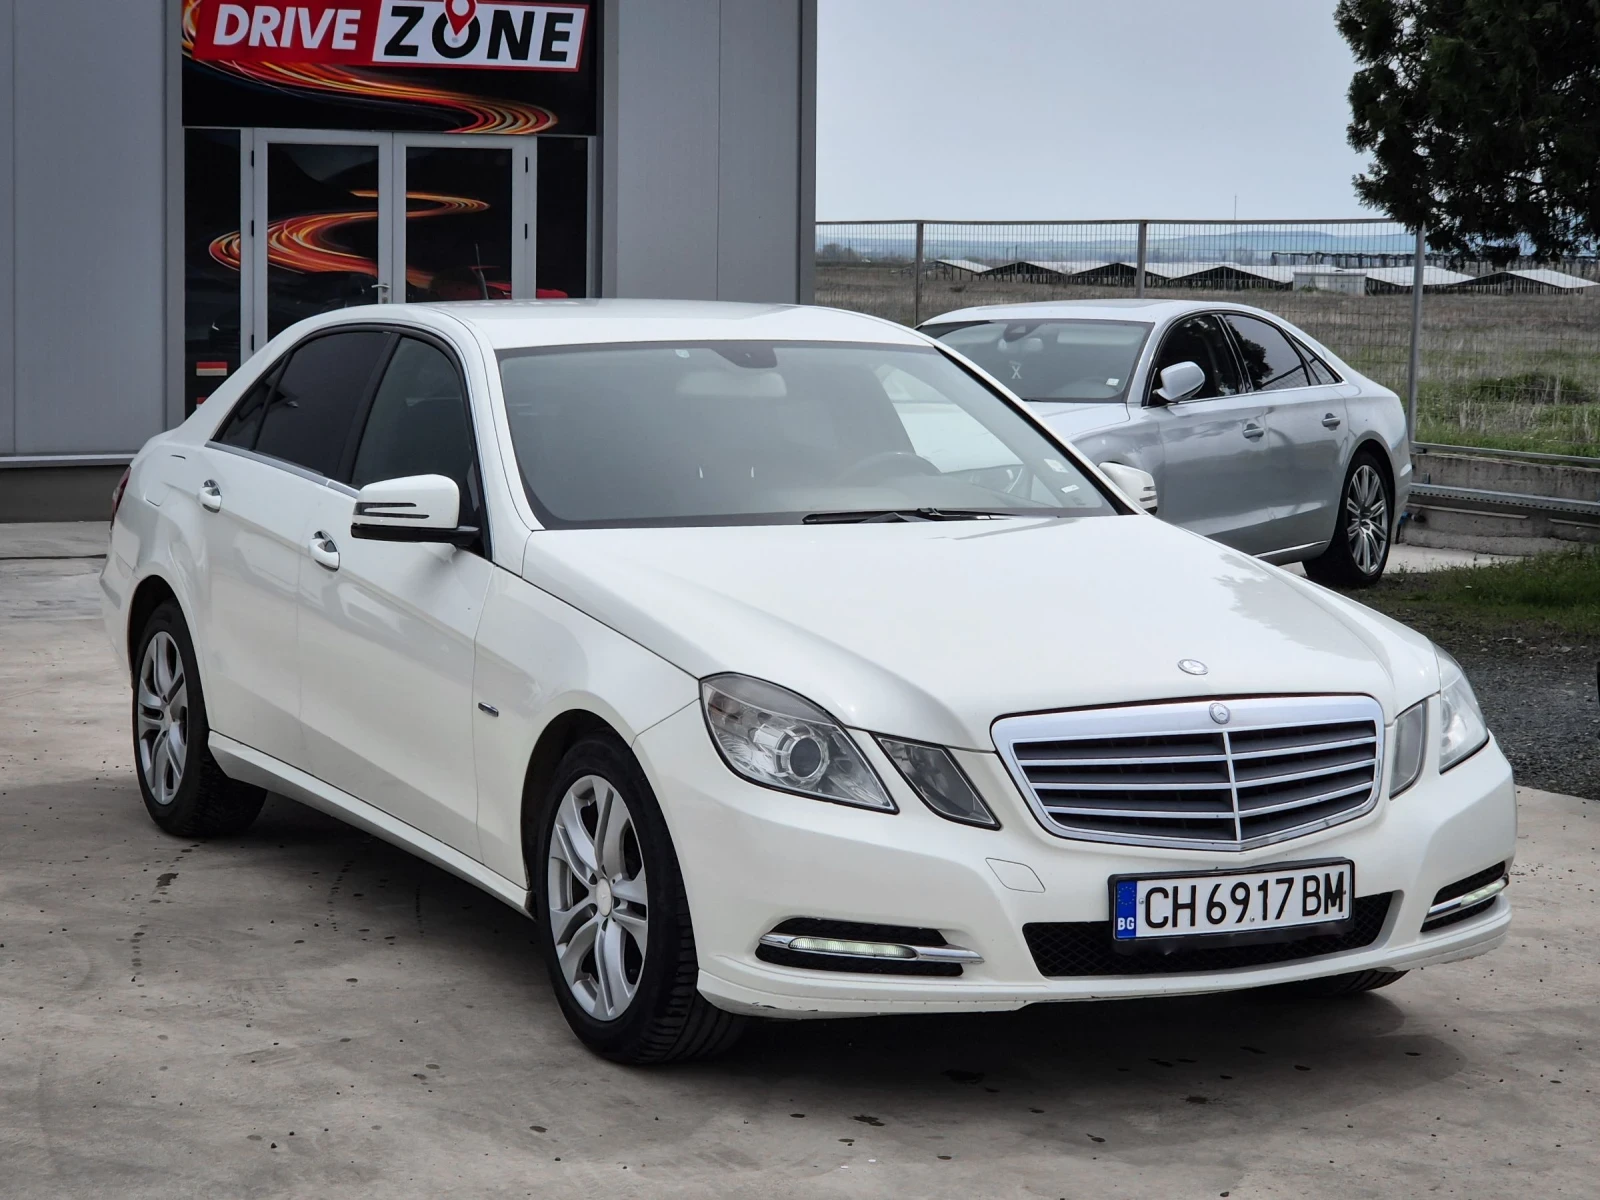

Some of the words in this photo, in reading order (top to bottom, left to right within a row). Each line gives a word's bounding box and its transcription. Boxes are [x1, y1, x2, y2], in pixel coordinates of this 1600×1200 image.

[213, 4, 362, 50] DRIVE
[384, 6, 574, 62] ZONE
[1117, 917, 1135, 931] BG
[1144, 884, 1197, 930] CH
[1206, 877, 1295, 926] 6917
[1302, 871, 1344, 918] BM
